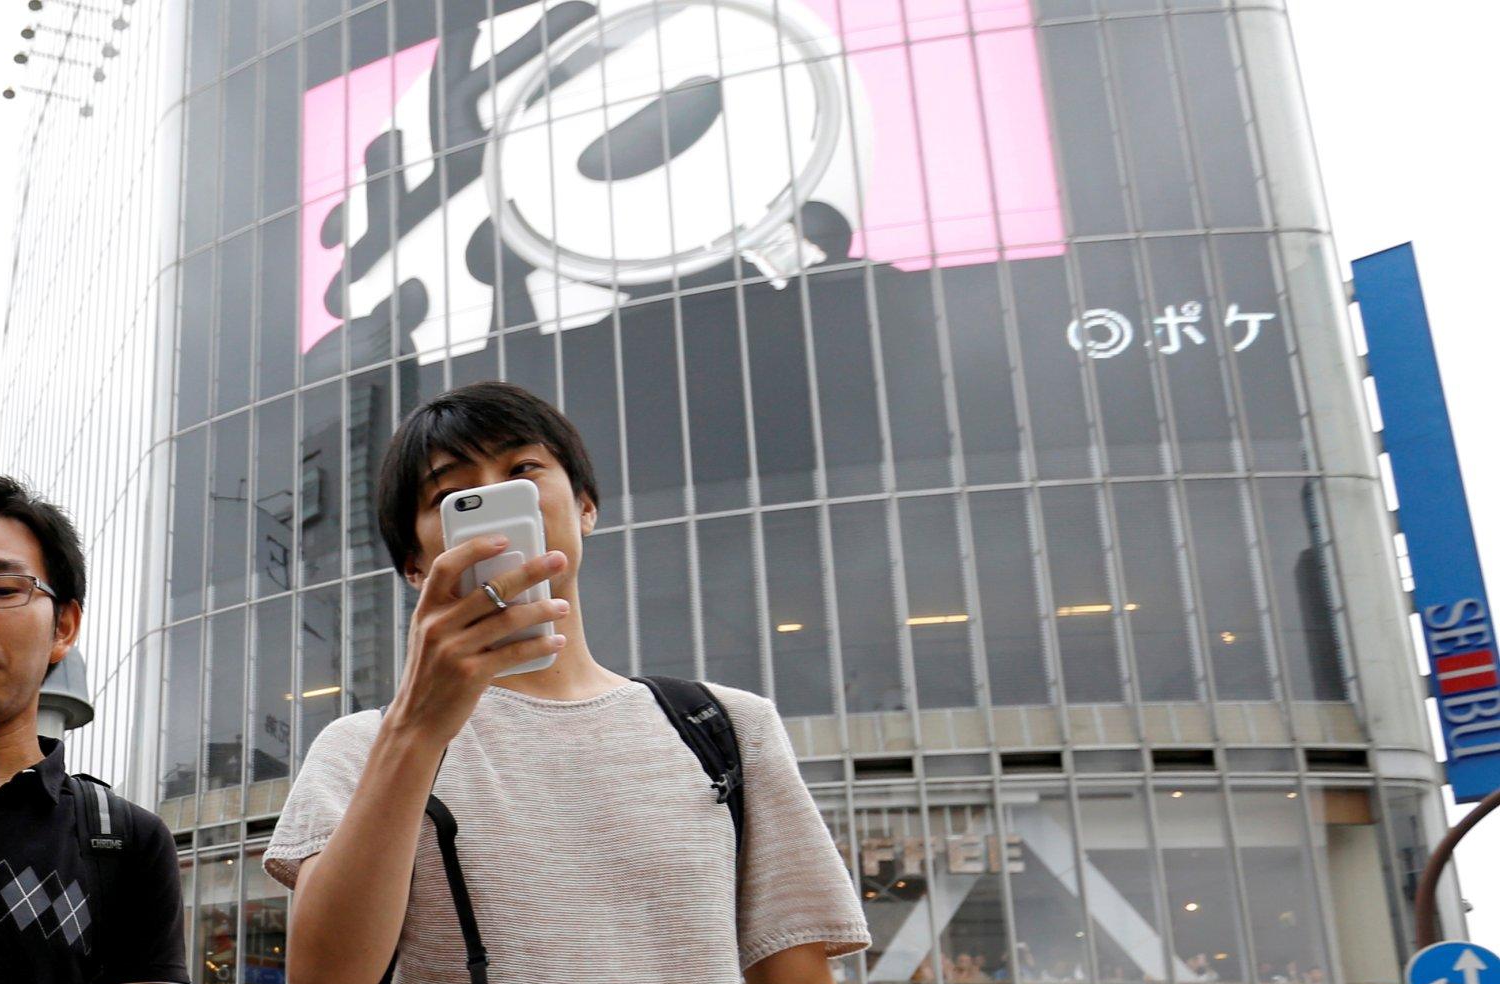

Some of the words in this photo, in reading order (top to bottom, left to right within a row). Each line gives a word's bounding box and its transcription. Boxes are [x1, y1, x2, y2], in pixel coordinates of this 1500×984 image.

[1425, 597, 1500, 759] SEIBU
[90, 838, 123, 850] CHROME
[836, 834, 1026, 876] FFEE
